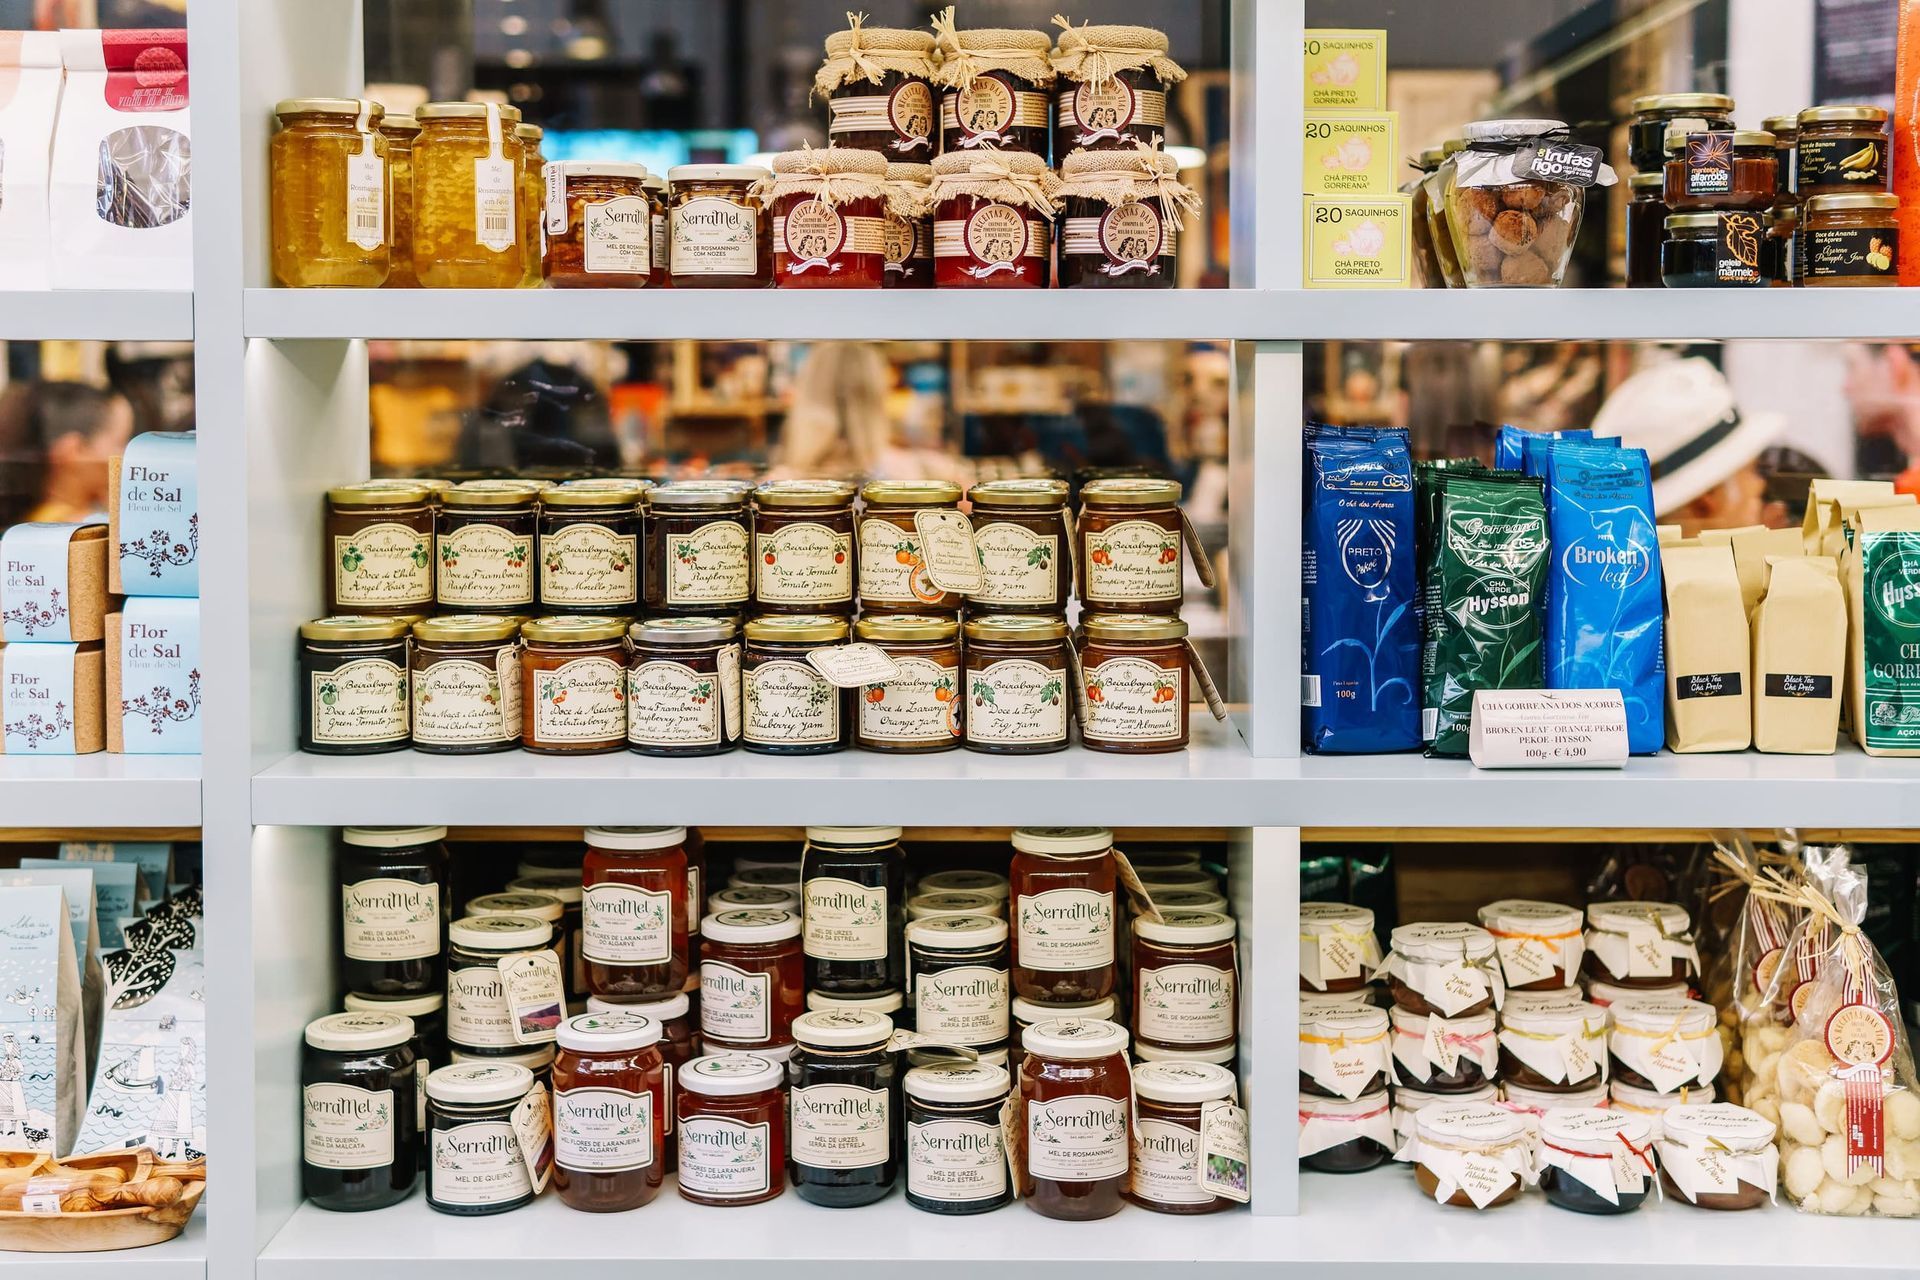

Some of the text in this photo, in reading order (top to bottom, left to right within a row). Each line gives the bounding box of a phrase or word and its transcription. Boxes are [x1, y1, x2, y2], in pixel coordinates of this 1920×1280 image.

[1306, 123, 1385, 138] 20 SAQUINHOS
[1545, 149, 1592, 167] trufas
[1531, 158, 1562, 175] figo
[1691, 173, 1728, 181] alfarroba
[681, 210, 741, 230] SerraMel
[1316, 207, 1398, 223] 20 SAQUINHOS
[129, 467, 169, 482] Flor
[128, 487, 182, 502] de Sal
[128, 503, 182, 512] Fleur de Sel
[1371, 500, 1394, 509] Açores
[1465, 518, 1539, 543] Gorreana
[1348, 547, 1382, 556] PRETO
[1575, 546, 1637, 565] Broken
[8, 561, 35, 572] Flor
[1902, 560, 1919, 568] CHÁ
[772, 566, 793, 577] Doce
[806, 566, 838, 577] Tomate
[1600, 565, 1633, 589] leaf
[8, 575, 45, 586] de Sal
[1469, 592, 1529, 615] Hysson
[129, 624, 168, 638] Flor
[128, 644, 181, 658] de Sal
[11, 673, 40, 684] Flor
[1710, 675, 1722, 683] Tea
[1784, 675, 1814, 684] Black Tea
[10, 688, 49, 699] de Sal
[1798, 684, 1815, 692] Preto
[1336, 690, 1356, 700] 100g
[325, 706, 345, 715] Doce
[357, 705, 388, 715] Tomate
[550, 705, 573, 715] Doce
[871, 702, 892, 712] Doce
[989, 704, 1010, 715] Doce
[1505, 702, 1559, 710] GORREANA
[328, 718, 352, 732] Green
[356, 718, 386, 726] Tomato
[1486, 726, 1523, 734] BROKEN
[1555, 725, 1593, 733] ORANGE
[1595, 724, 1624, 732] PEKOE
[1520, 735, 1592, 744] PEKOE HYSSON
[1526, 749, 1547, 759] 100g
[1563, 747, 1586, 758] 4,90
[353, 892, 421, 913] SerraMel
[589, 895, 650, 918] SerraMel
[1033, 901, 1104, 922] SerraMel
[1060, 940, 1100, 948] ROSMANINHO
[933, 978, 1001, 1001] SerraMel
[1155, 975, 1223, 997] SerraMel
[460, 1016, 473, 1024] MEL
[307, 1094, 372, 1120] SerraMel
[566, 1099, 634, 1123] SerraMel
[802, 1095, 872, 1120] SerraMel
[1043, 1108, 1117, 1132] SerraMel
[838, 1141, 866, 1149] ESTRELA
[921, 1129, 991, 1153] SerraMel
[1072, 1148, 1114, 1158] ROSMANINHO
